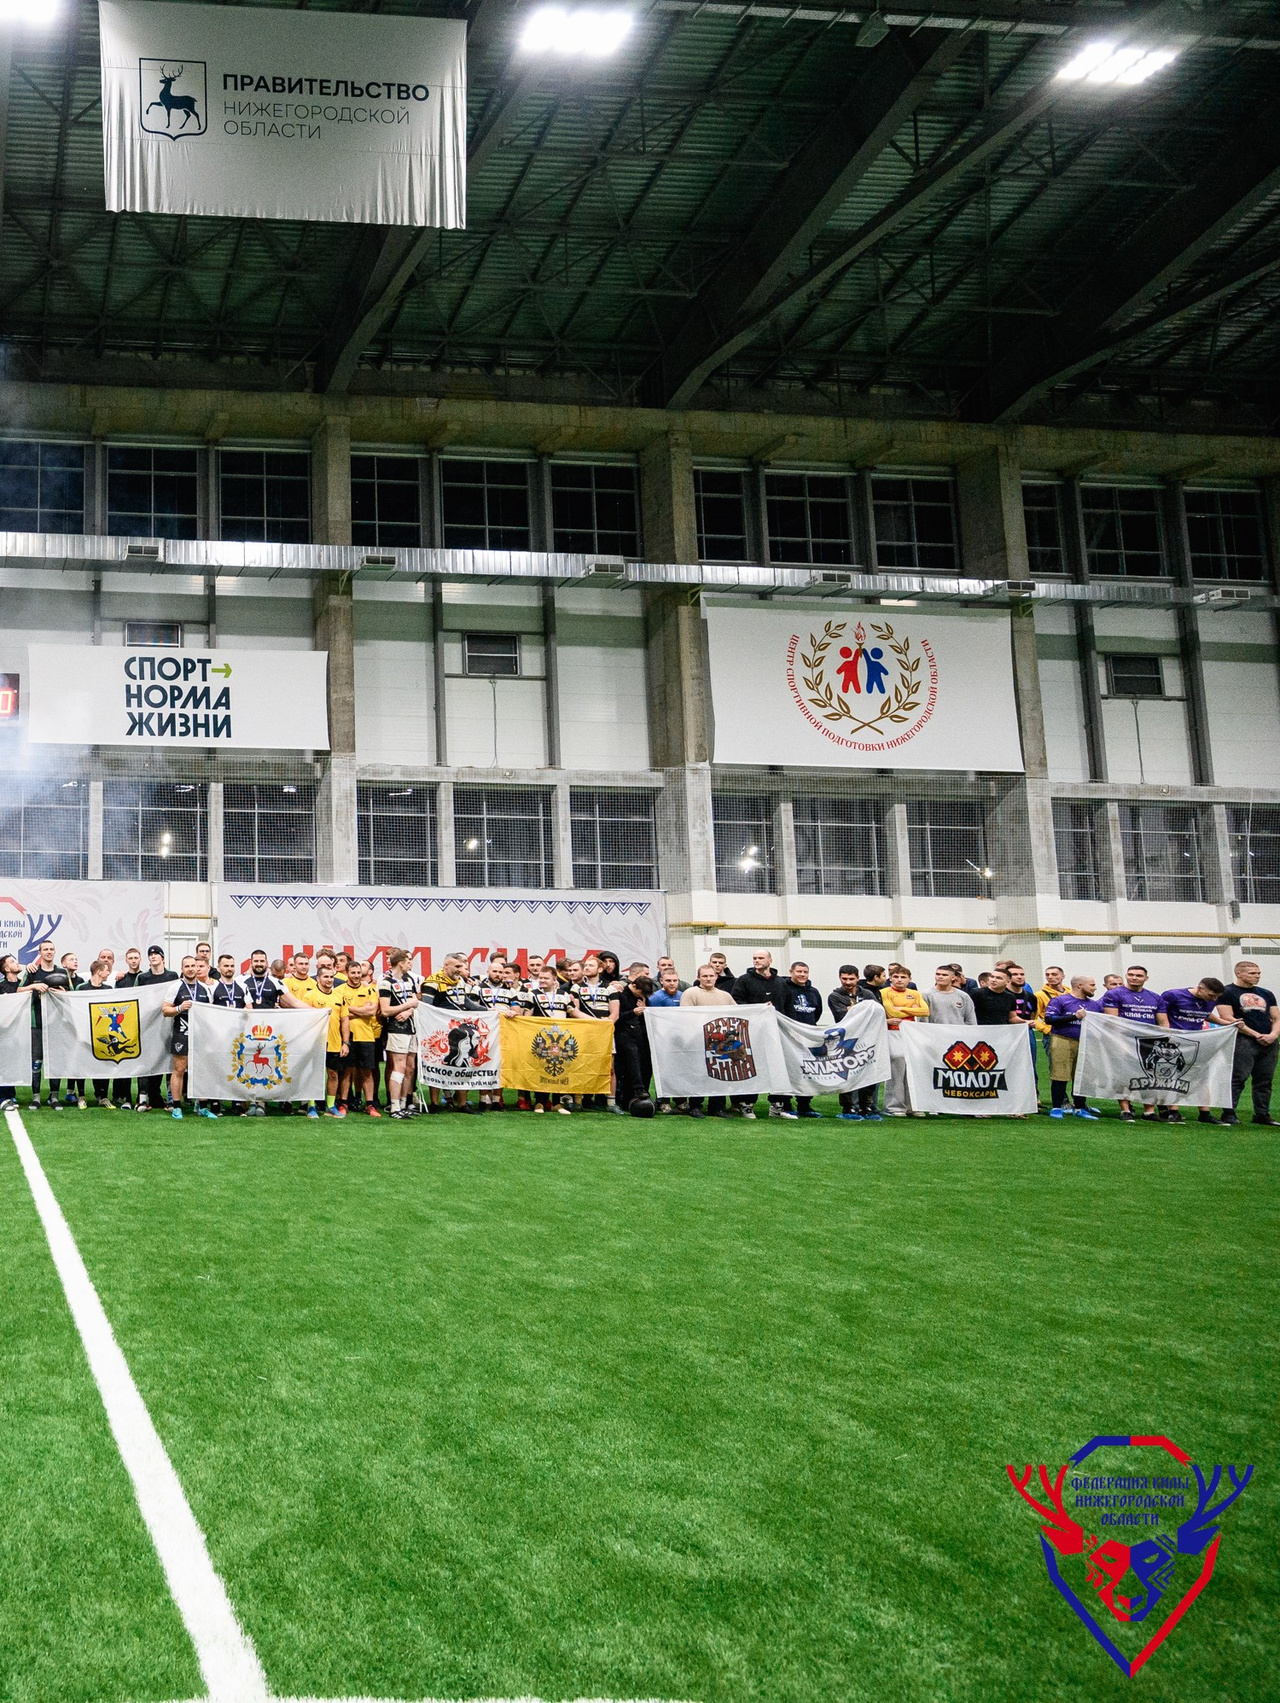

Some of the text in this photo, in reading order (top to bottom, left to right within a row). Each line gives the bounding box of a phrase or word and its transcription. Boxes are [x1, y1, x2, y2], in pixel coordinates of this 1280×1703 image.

[222, 73, 430, 102] ПРАВИТЕЛЬСТВО
[224, 100, 410, 125] НИЖЕГОРОДСКОЙ
[223, 120, 322, 139] ОБЛАСТИ
[124, 656, 212, 682] СПОРТ
[125, 684, 231, 711] НОРМА
[786, 633, 939, 752] ЦЕНТР СПОРТИВНОЙ ПОДГОТОВКИ НИЖЕГОРОДСКОЙ ОБЛАСТИ
[125, 711, 232, 739] ЖИЗНИ
[4, 920, 26, 929] КИЛЫ
[800, 1045, 876, 1076] AVIATORS
[937, 1069, 1006, 1089] МОЛОТ
[1130, 1077, 1190, 1094] ДРУЖИНА
[944, 1089, 997, 1099] ЧЕБОКСАРЫ
